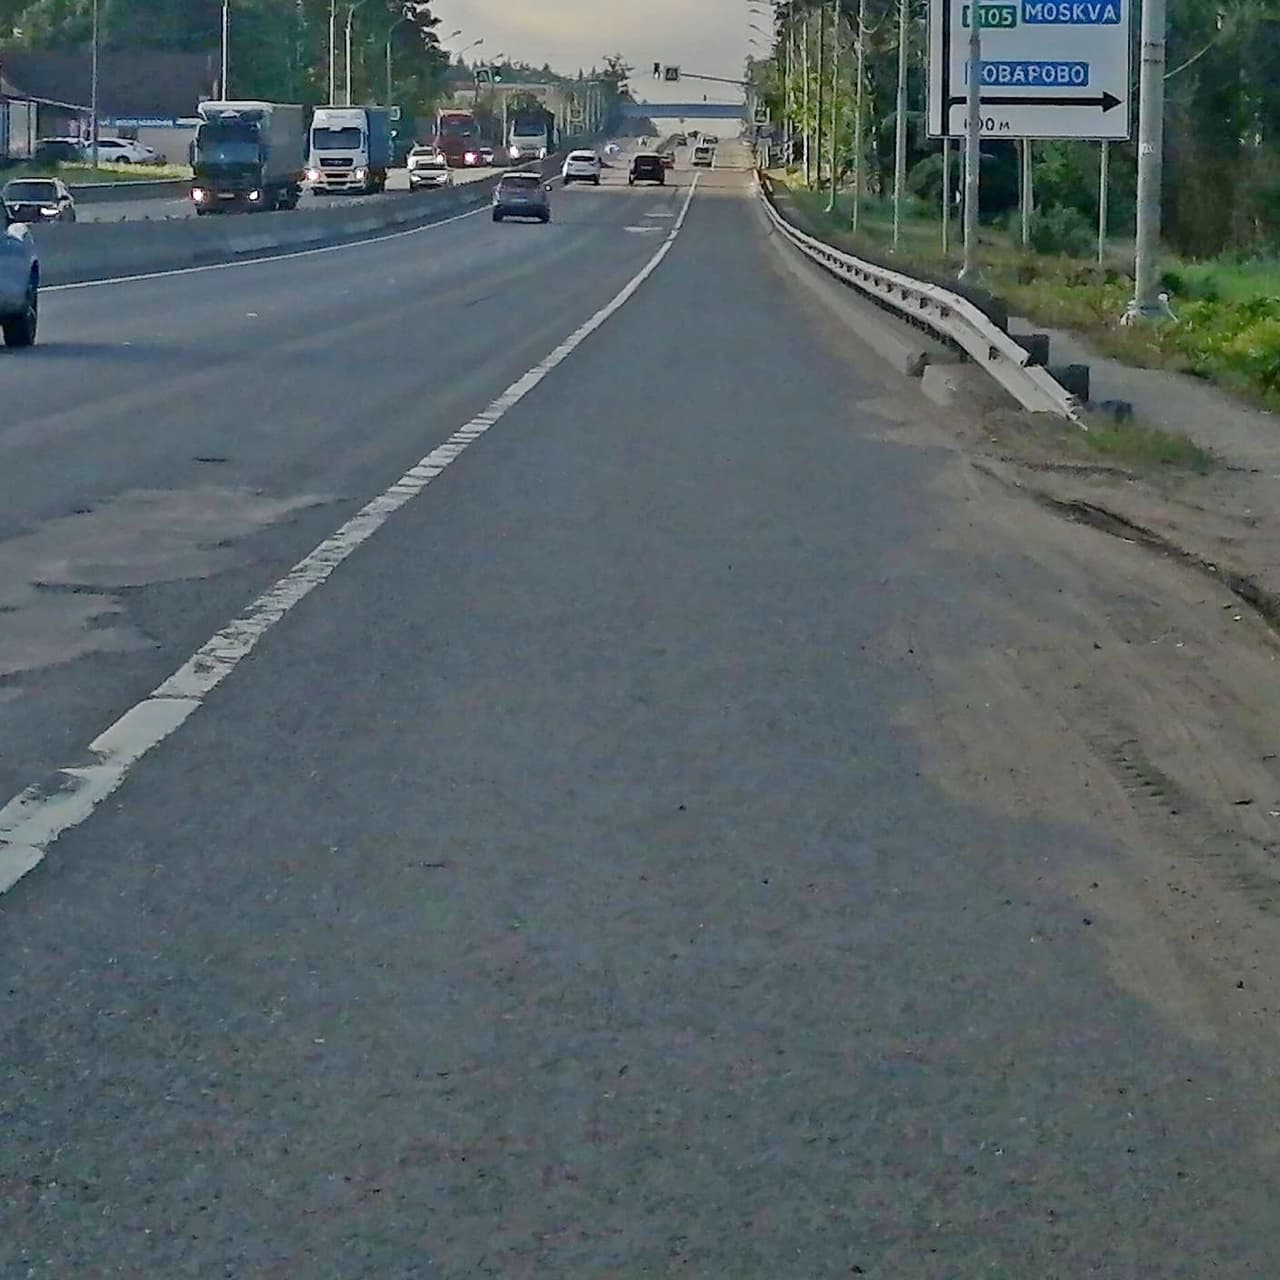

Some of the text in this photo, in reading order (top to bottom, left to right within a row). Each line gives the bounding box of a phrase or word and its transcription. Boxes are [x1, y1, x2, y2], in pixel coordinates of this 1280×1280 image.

[970, 2, 1118, 25] 105 MOSKVA
[971, 64, 1085, 83] ОВАРОВО
